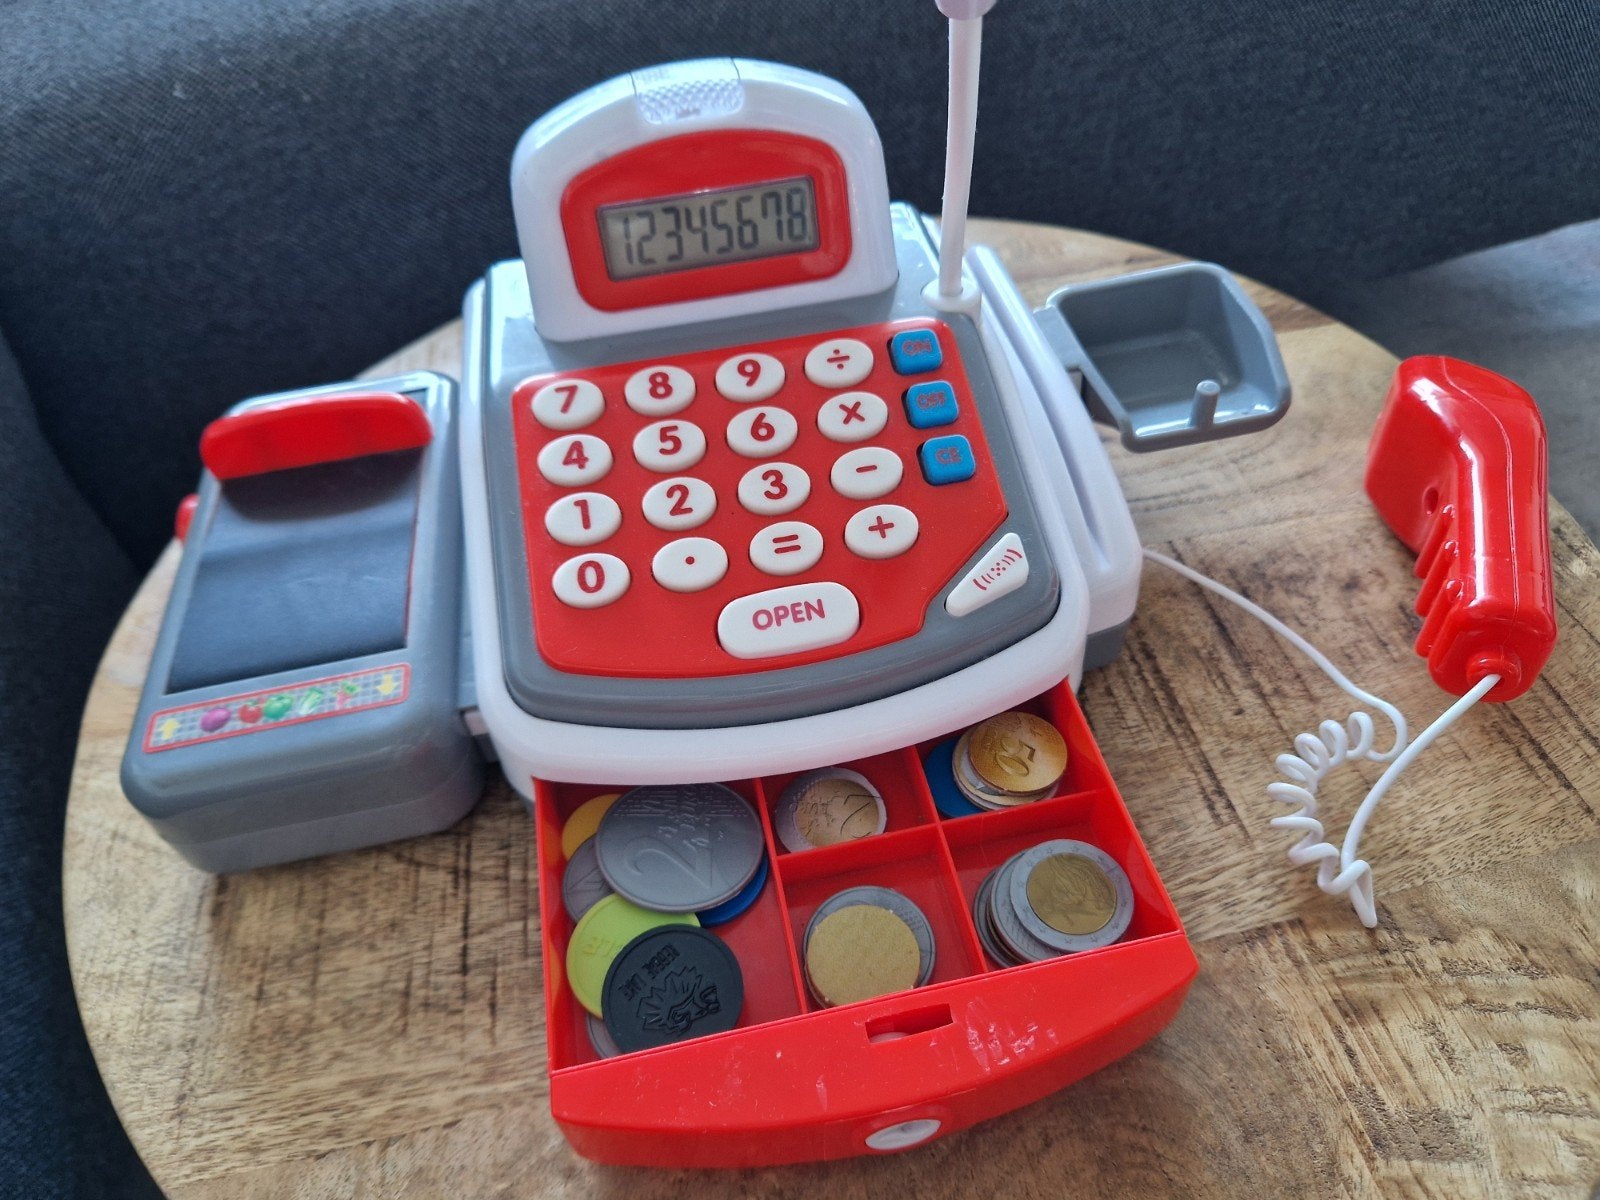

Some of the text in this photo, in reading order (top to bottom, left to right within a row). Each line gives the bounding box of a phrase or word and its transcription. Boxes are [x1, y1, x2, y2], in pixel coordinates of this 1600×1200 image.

[624, 187, 807, 265] 12345678
[902, 339, 932, 356] ON
[649, 371, 673, 400] 8
[737, 358, 762, 387] 9
[556, 385, 578, 413] 7
[917, 391, 946, 409] OFF
[659, 425, 682, 455] 5
[750, 412, 776, 442] 6
[563, 441, 589, 469] 4
[936, 447, 962, 464] CE
[666, 484, 693, 516] 2
[762, 470, 788, 500] 3
[574, 499, 591, 530] 1
[577, 560, 605, 594] 0
[752, 600, 825, 631] OPEN
[622, 836, 713, 891] 2
